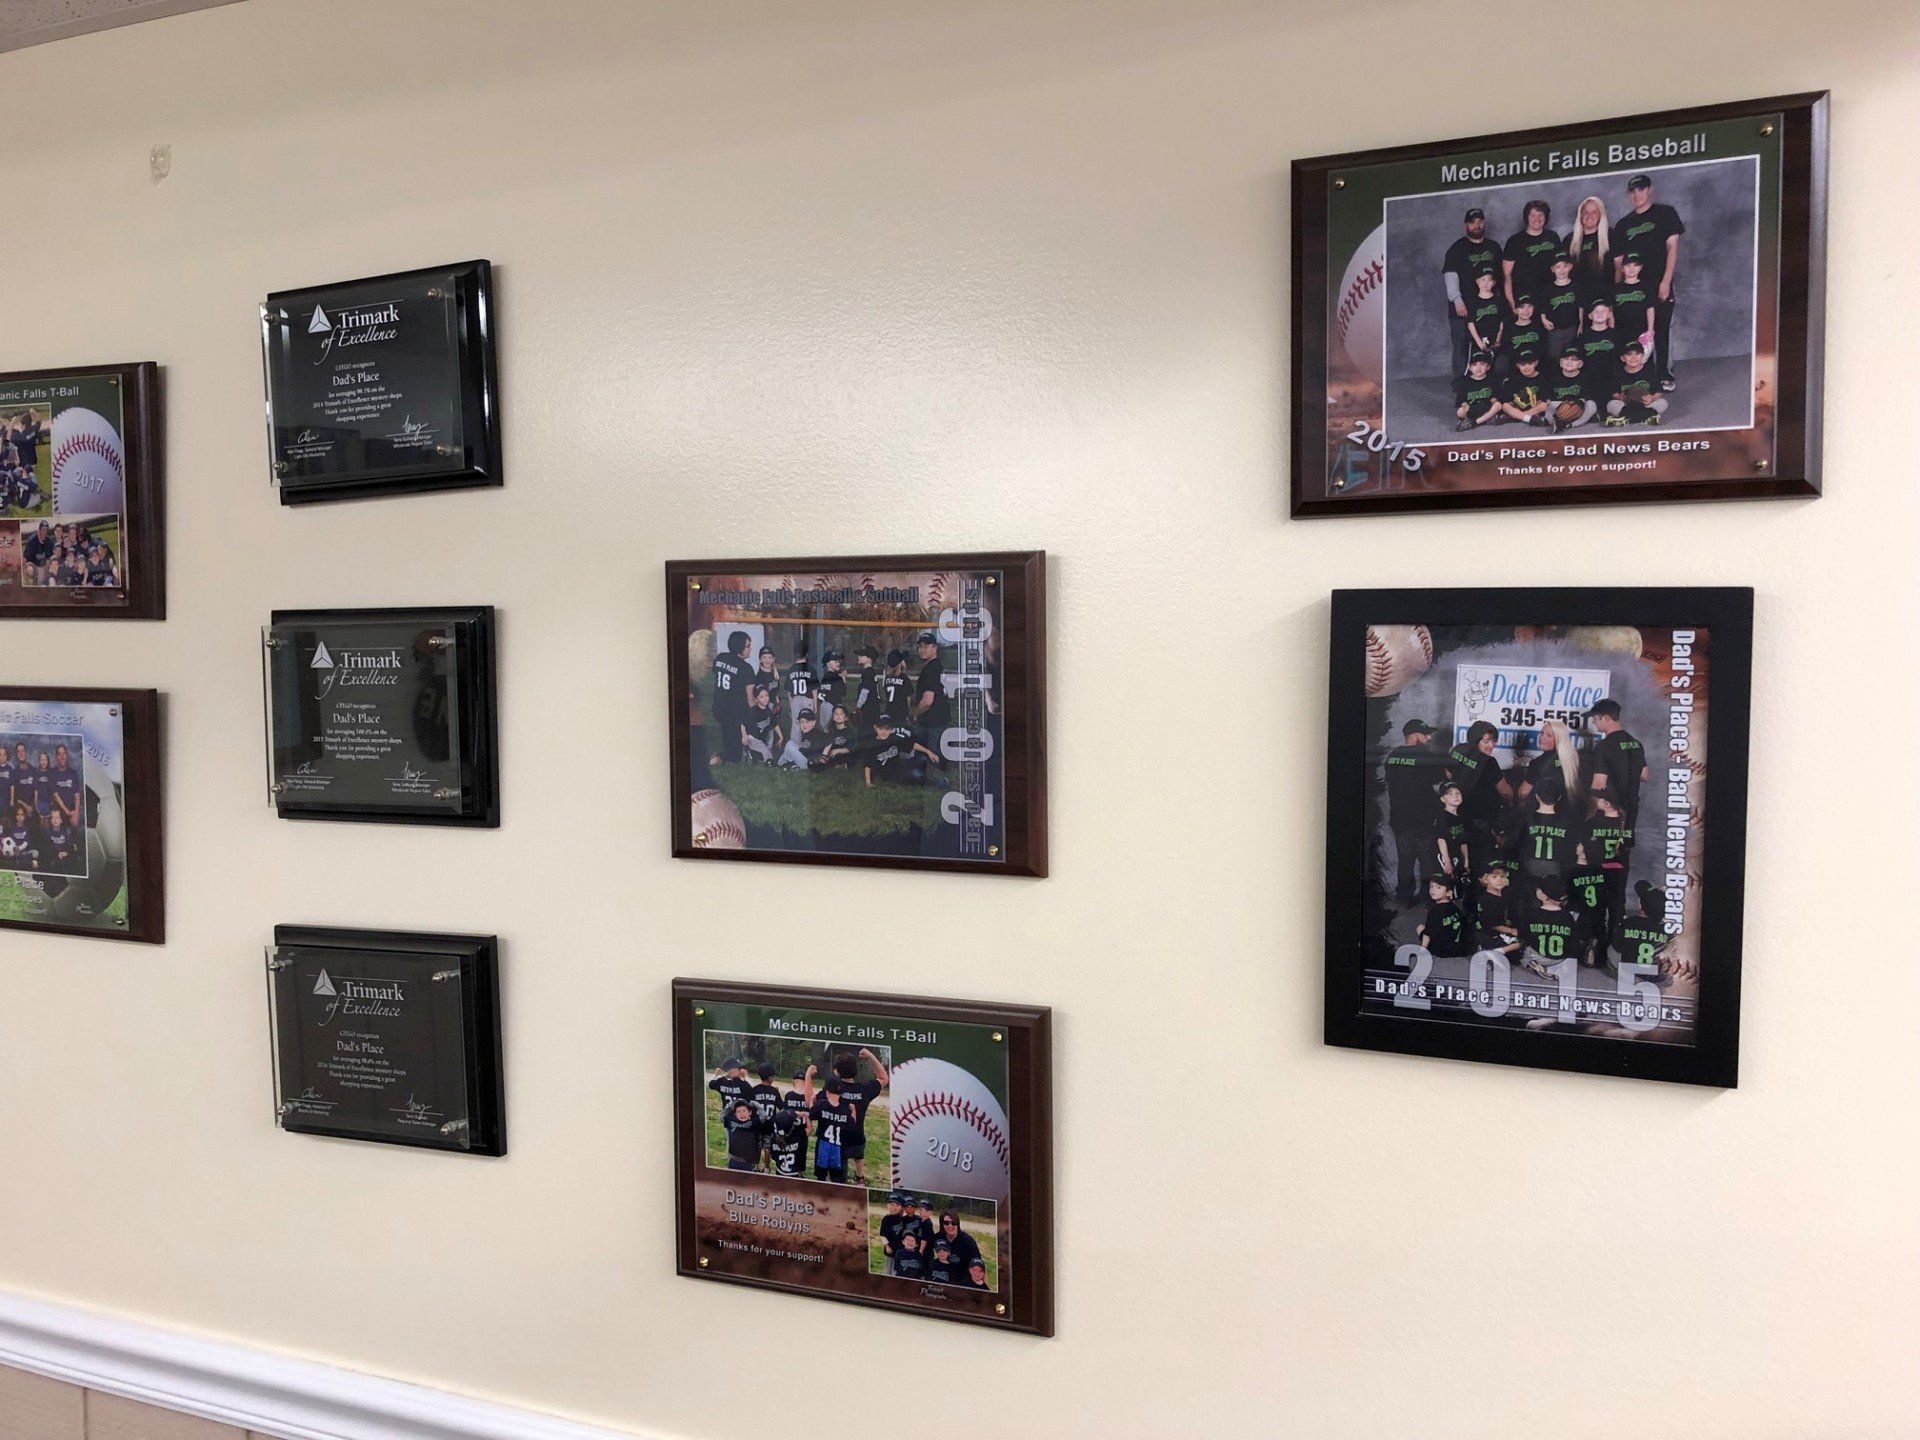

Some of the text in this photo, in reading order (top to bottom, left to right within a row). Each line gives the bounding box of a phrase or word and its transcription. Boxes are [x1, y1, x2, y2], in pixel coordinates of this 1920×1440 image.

[1441, 133, 1707, 184] Mechanic Falls Baseball
[339, 304, 400, 330] Trimark
[314, 325, 398, 365] of Excellence
[332, 371, 380, 386] Dad's Place
[0, 386, 79, 400] anic Falls T-Ball
[1346, 420, 1427, 471] 2015
[1448, 448, 1494, 463] Dad's
[1500, 447, 1546, 460] Place
[1563, 444, 1597, 457] Bad
[1603, 441, 1651, 456] News
[1658, 438, 1711, 452] Bears
[1498, 460, 1657, 476] Thanks for your support!
[74, 470, 104, 495] 2017
[700, 590, 761, 605] Mechanic
[762, 588, 796, 604] Falls
[795, 587, 852, 604] Baseball
[867, 586, 920, 603] Softball
[340, 651, 402, 669] Trimark
[1671, 630, 1696, 688] Dad's
[314, 664, 399, 700] of Excellence
[717, 671, 731, 690] 16
[793, 679, 807, 695] 10
[1488, 673, 1603, 709] Dad's Place
[15, 711, 40, 725] Falls
[44, 712, 83, 726] Soccer
[333, 713, 381, 724] Dad's Place
[1669, 692, 1694, 750] Place
[965, 711, 981, 773] Place
[87, 743, 111, 767] 2016
[1668, 768, 1692, 809] Bad
[965, 781, 981, 843] Dad's
[1592, 828, 1612, 838] DAD'S
[1665, 812, 1690, 870] News
[1535, 836, 1553, 860] 11
[1604, 839, 1620, 860] 5
[15, 876, 44, 890] Place
[1584, 885, 1597, 907] 9
[1664, 873, 1689, 935] Bears
[1538, 934, 1564, 957] 10
[1624, 929, 1647, 940] DAD'S
[1637, 943, 1655, 965] 8
[343, 981, 404, 1001] Trimark
[1394, 944, 1661, 1031] 2015
[317, 992, 401, 1026] of Excellence
[1375, 979, 1427, 998] Dad's
[1436, 985, 1490, 1004] Place
[1514, 991, 1549, 1007] Bad
[1559, 996, 1611, 1015] News
[1619, 1002, 1682, 1022] Bears
[769, 1018, 937, 1044] Mechanic Falls T-Ball
[337, 1041, 384, 1054] Dad's Place
[824, 1124, 842, 1146] 41
[926, 1136, 974, 1172] 2018
[725, 1189, 814, 1215] Dad's Place
[729, 1211, 811, 1234] Blue Robyns
[718, 1239, 824, 1263] Thanks for your support!
